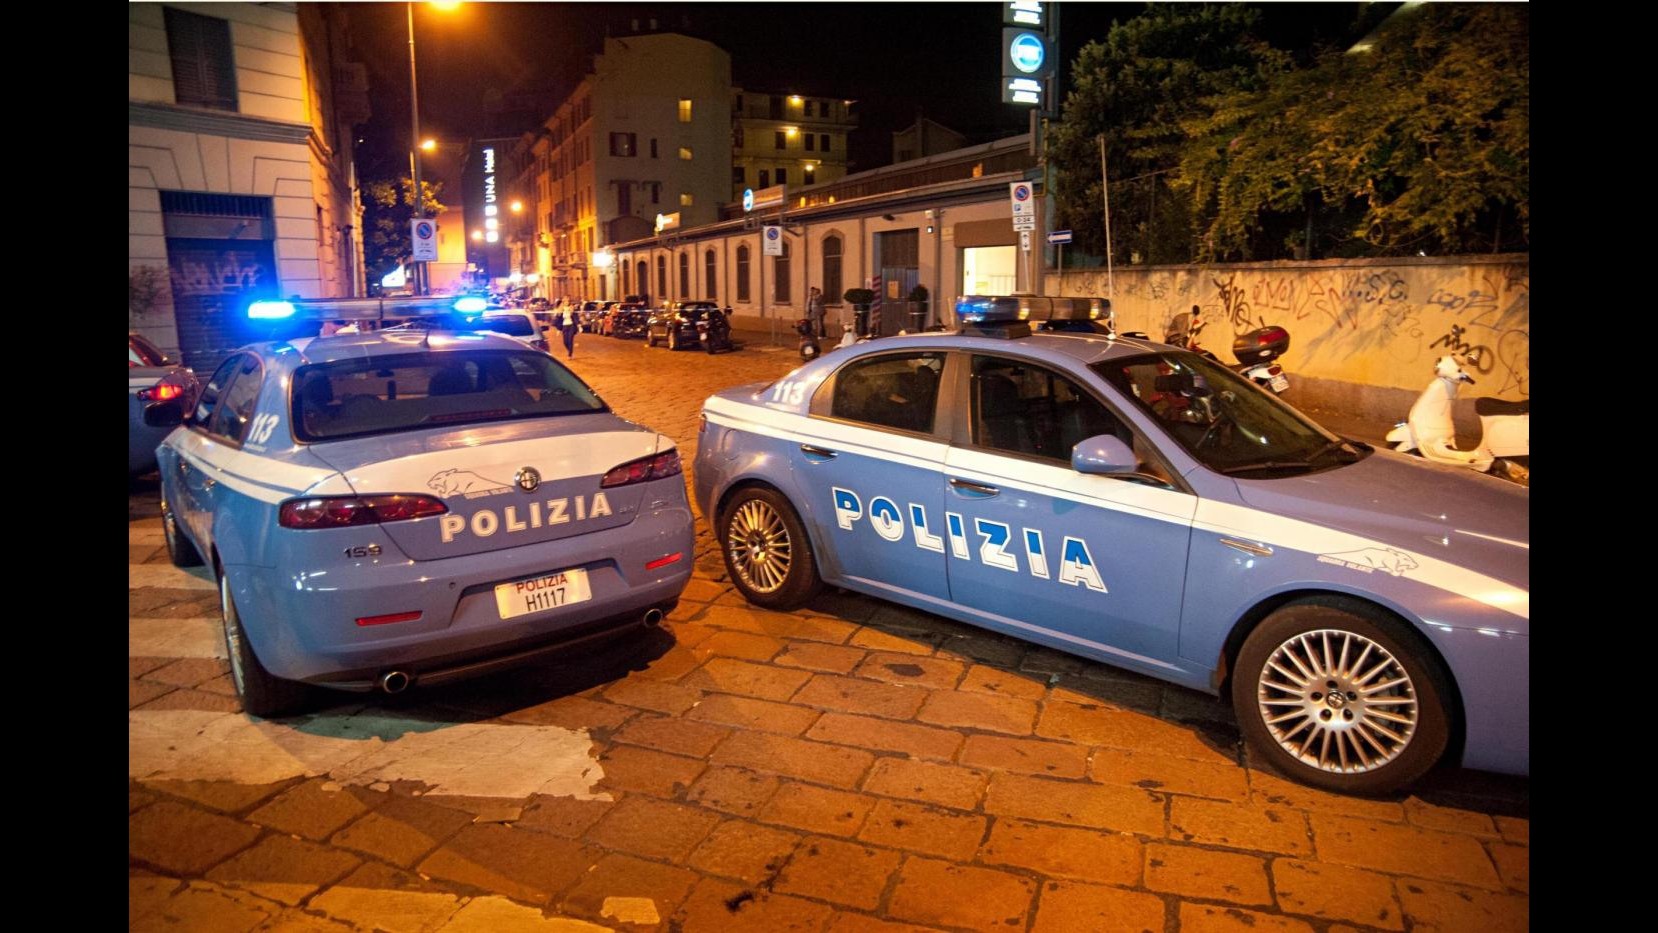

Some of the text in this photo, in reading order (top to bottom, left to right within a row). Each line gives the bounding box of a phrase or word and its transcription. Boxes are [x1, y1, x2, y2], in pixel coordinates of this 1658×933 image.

[485, 175, 497, 203] UNA
[772, 380, 806, 405] 113
[248, 412, 280, 443] 113
[439, 492, 613, 544] POLIZIA
[343, 544, 383, 559] 159
[831, 486, 1109, 594] POLIZIA
[516, 573, 569, 594] POLIZIA
[525, 587, 567, 612] H1117
